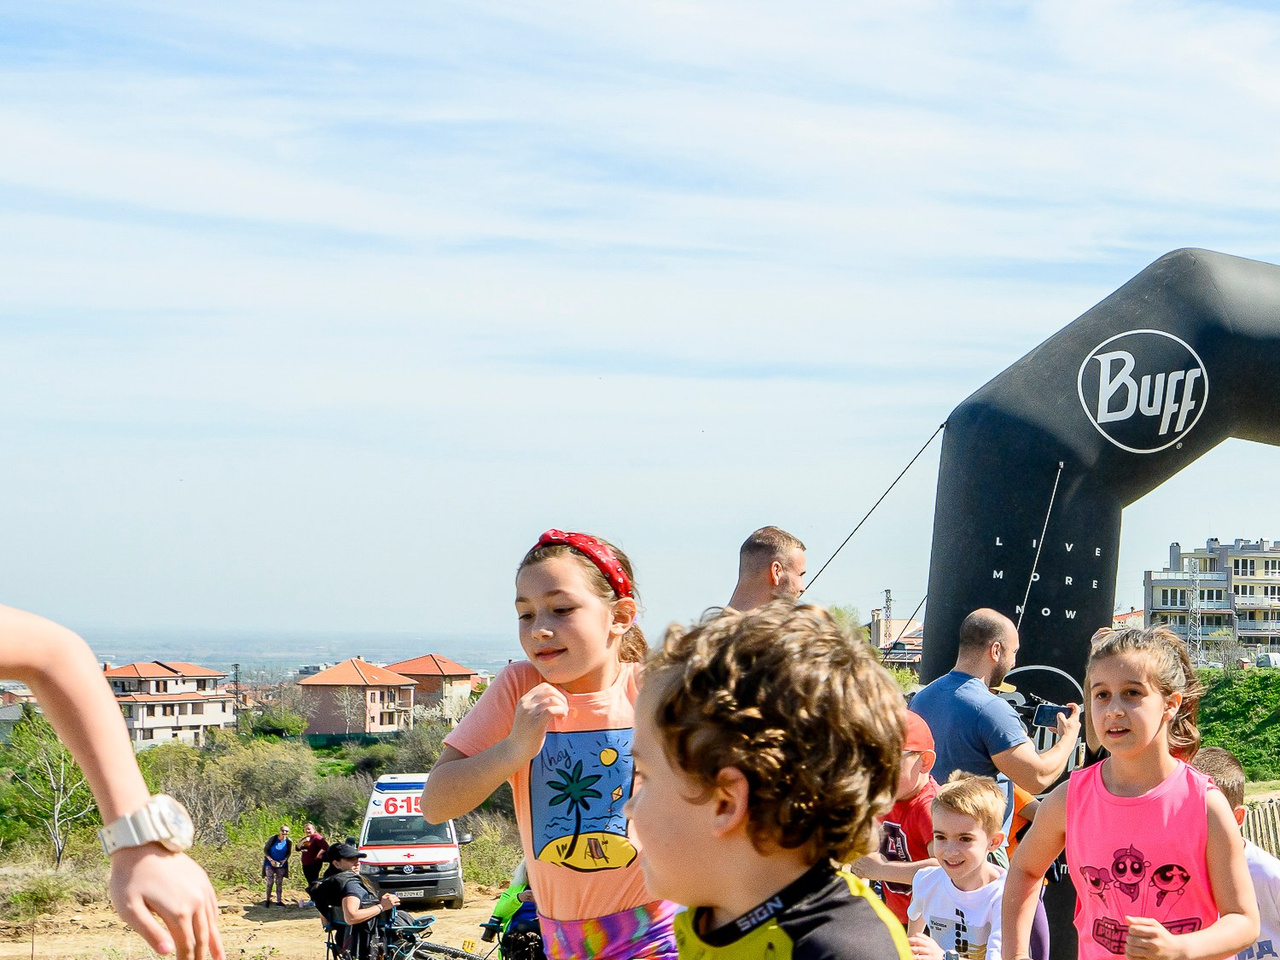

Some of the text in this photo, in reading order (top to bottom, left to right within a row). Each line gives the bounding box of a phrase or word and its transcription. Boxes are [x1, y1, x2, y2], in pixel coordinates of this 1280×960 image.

[1091, 350, 1201, 436] Buff
[995, 537, 1101, 556] LIVE
[992, 570, 1098, 588] MORE
[1015, 605, 1076, 619] NOW
